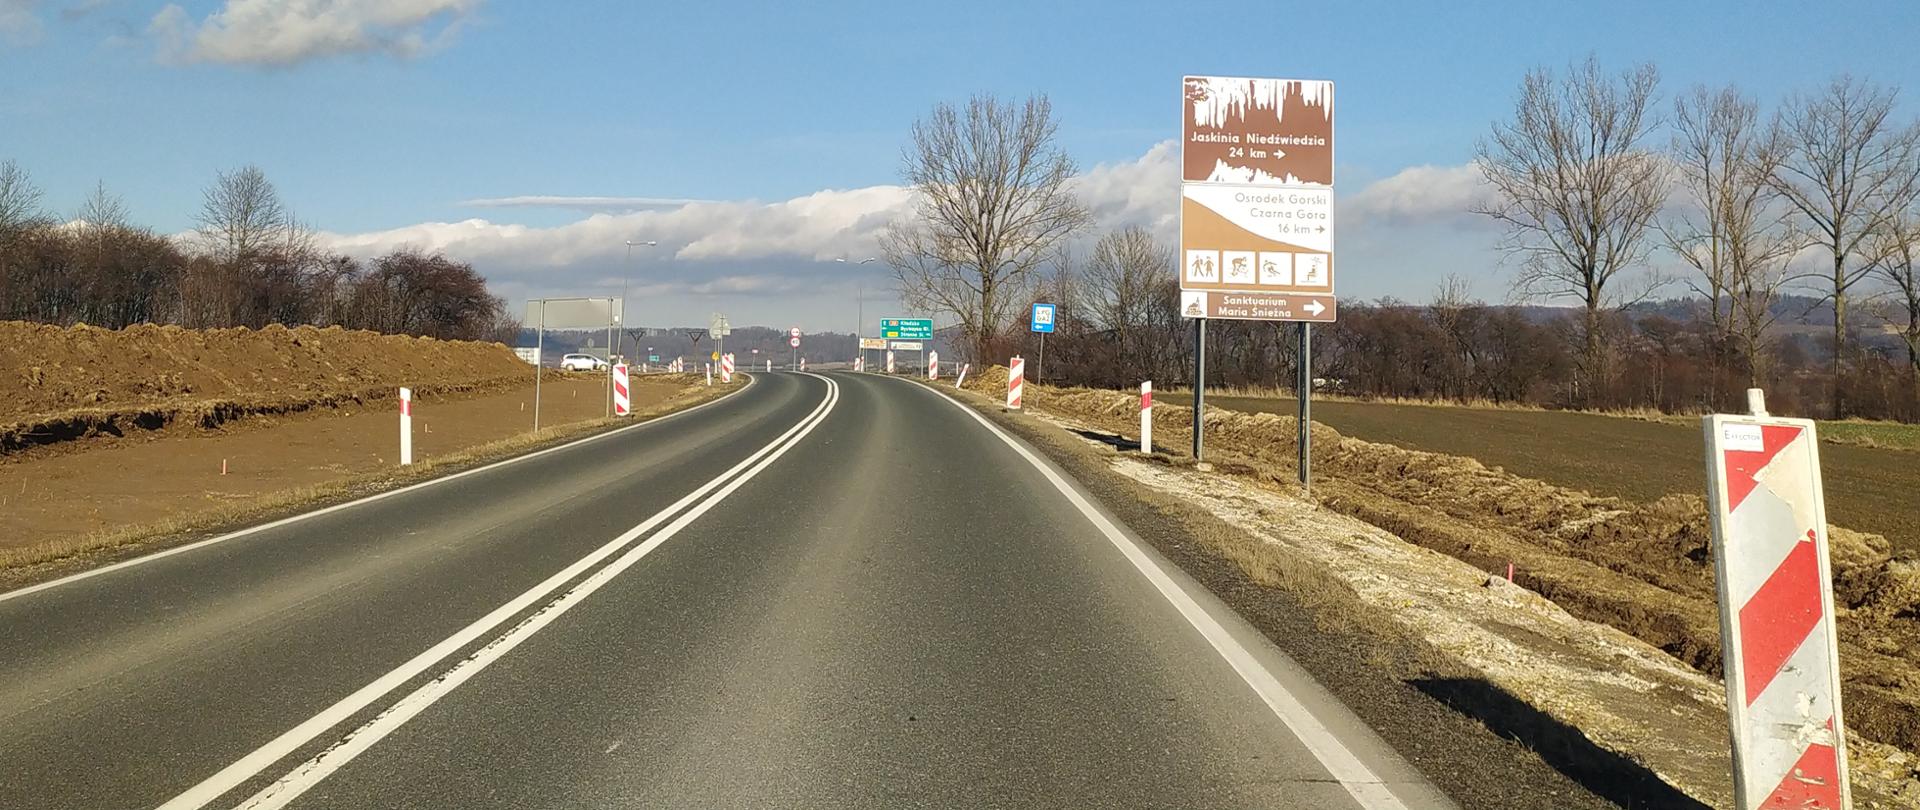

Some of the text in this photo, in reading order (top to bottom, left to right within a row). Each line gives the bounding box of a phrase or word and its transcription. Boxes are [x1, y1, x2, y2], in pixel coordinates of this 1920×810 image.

[1191, 131, 1326, 146] Jaskinia Niedźwiedzia
[1229, 147, 1267, 159] 24 km
[1250, 208, 1292, 219] Czarna
[1278, 223, 1311, 234] 16 km
[1223, 295, 1287, 307] Sanktuarium
[1218, 305, 1292, 318] Maria Śnieżna
